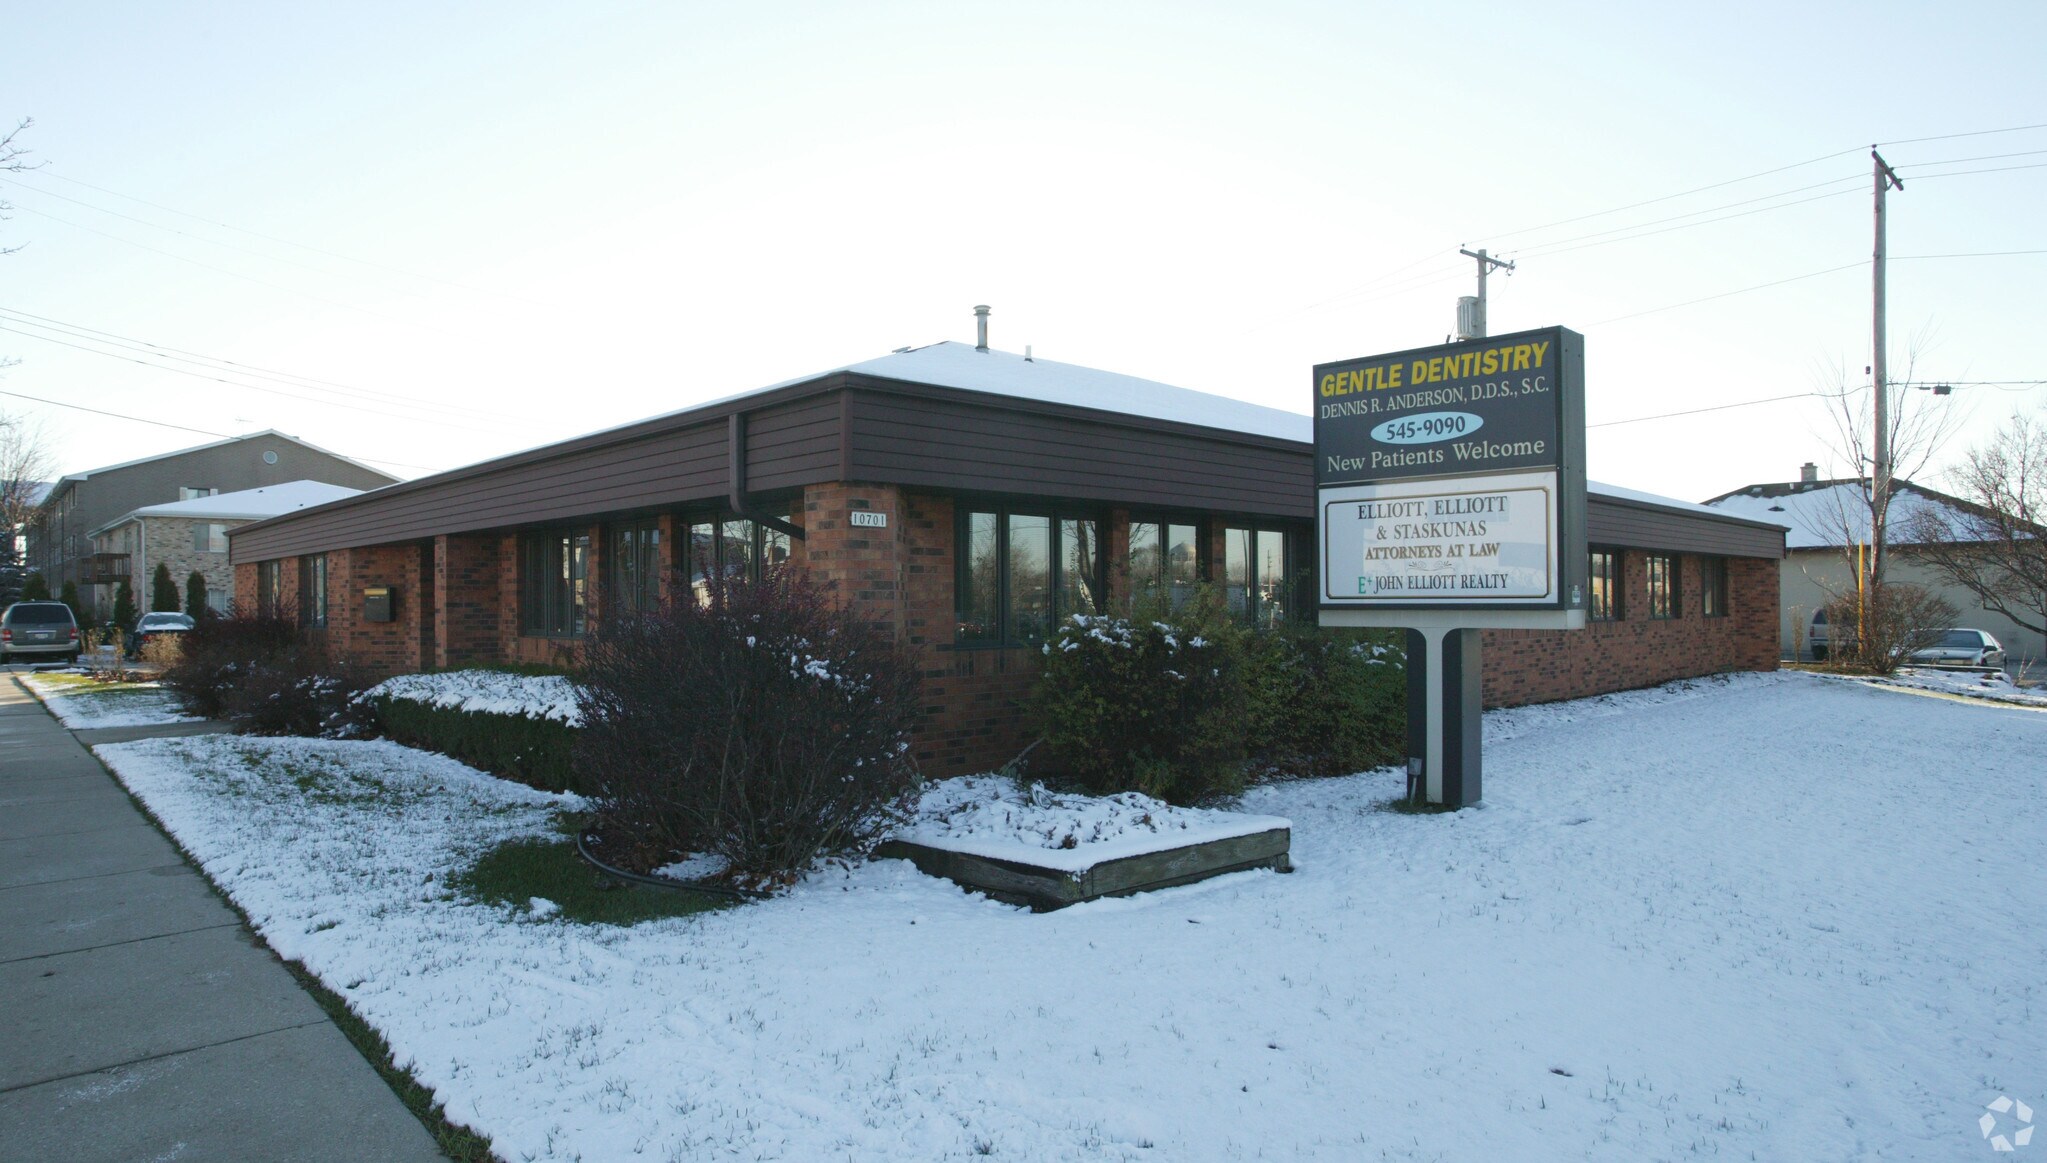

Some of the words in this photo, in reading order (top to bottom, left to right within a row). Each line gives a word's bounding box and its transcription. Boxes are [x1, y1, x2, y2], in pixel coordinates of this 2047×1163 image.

[1320, 363, 1403, 398] GENTLE
[1411, 341, 1549, 386] DENTISTRY
[1321, 399, 1368, 419] DENNIS
[1371, 397, 1383, 413] R.
[1386, 386, 1467, 411] ANDERSON,
[1471, 380, 1518, 401] D.D.S.,
[1521, 376, 1549, 395] S.C.
[1386, 415, 1466, 441] 545-9090
[1327, 455, 1366, 472] New
[1371, 448, 1444, 469] Patients
[1452, 440, 1545, 461] Welcome
[853, 512, 885, 527] 10701
[1358, 501, 1428, 520] ELLIOTT,
[1434, 495, 1508, 516] ELLIOTT
[1376, 525, 1388, 541] &
[1394, 520, 1487, 540] STASKUNAS
[1365, 545, 1442, 561] ATTORNEYS
[1446, 543, 1464, 558] AT
[1469, 542, 1500, 558] LAW
[1373, 575, 1404, 595] JOHN
[1408, 574, 1457, 590] ELLIOTT
[1460, 573, 1509, 589] REALTY
